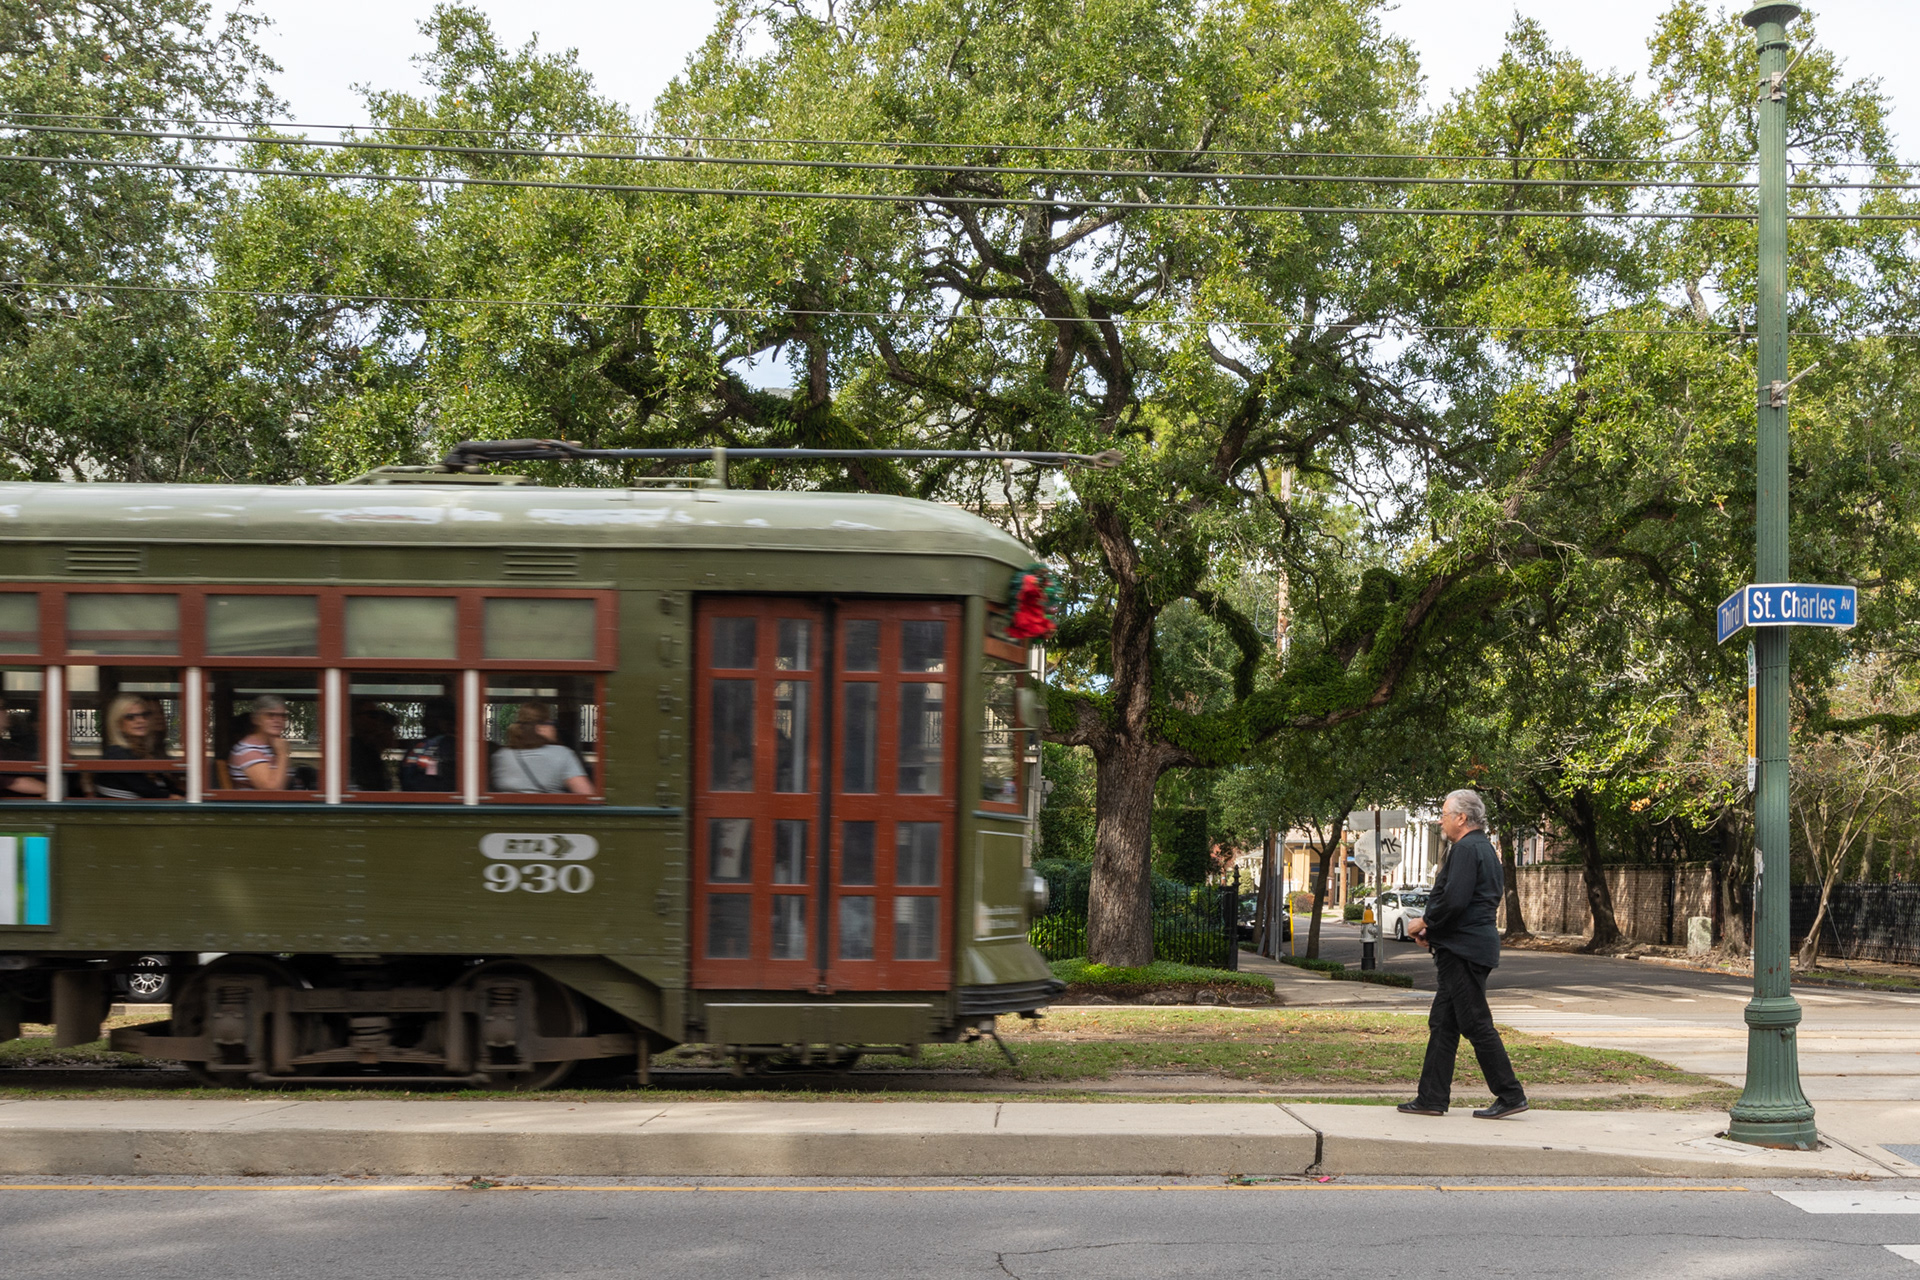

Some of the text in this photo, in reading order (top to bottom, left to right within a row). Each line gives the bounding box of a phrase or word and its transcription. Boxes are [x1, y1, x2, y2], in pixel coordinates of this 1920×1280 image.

[1721, 598, 1740, 635] Third
[1752, 589, 1852, 620] St. Charles Av
[482, 863, 595, 893] 930
